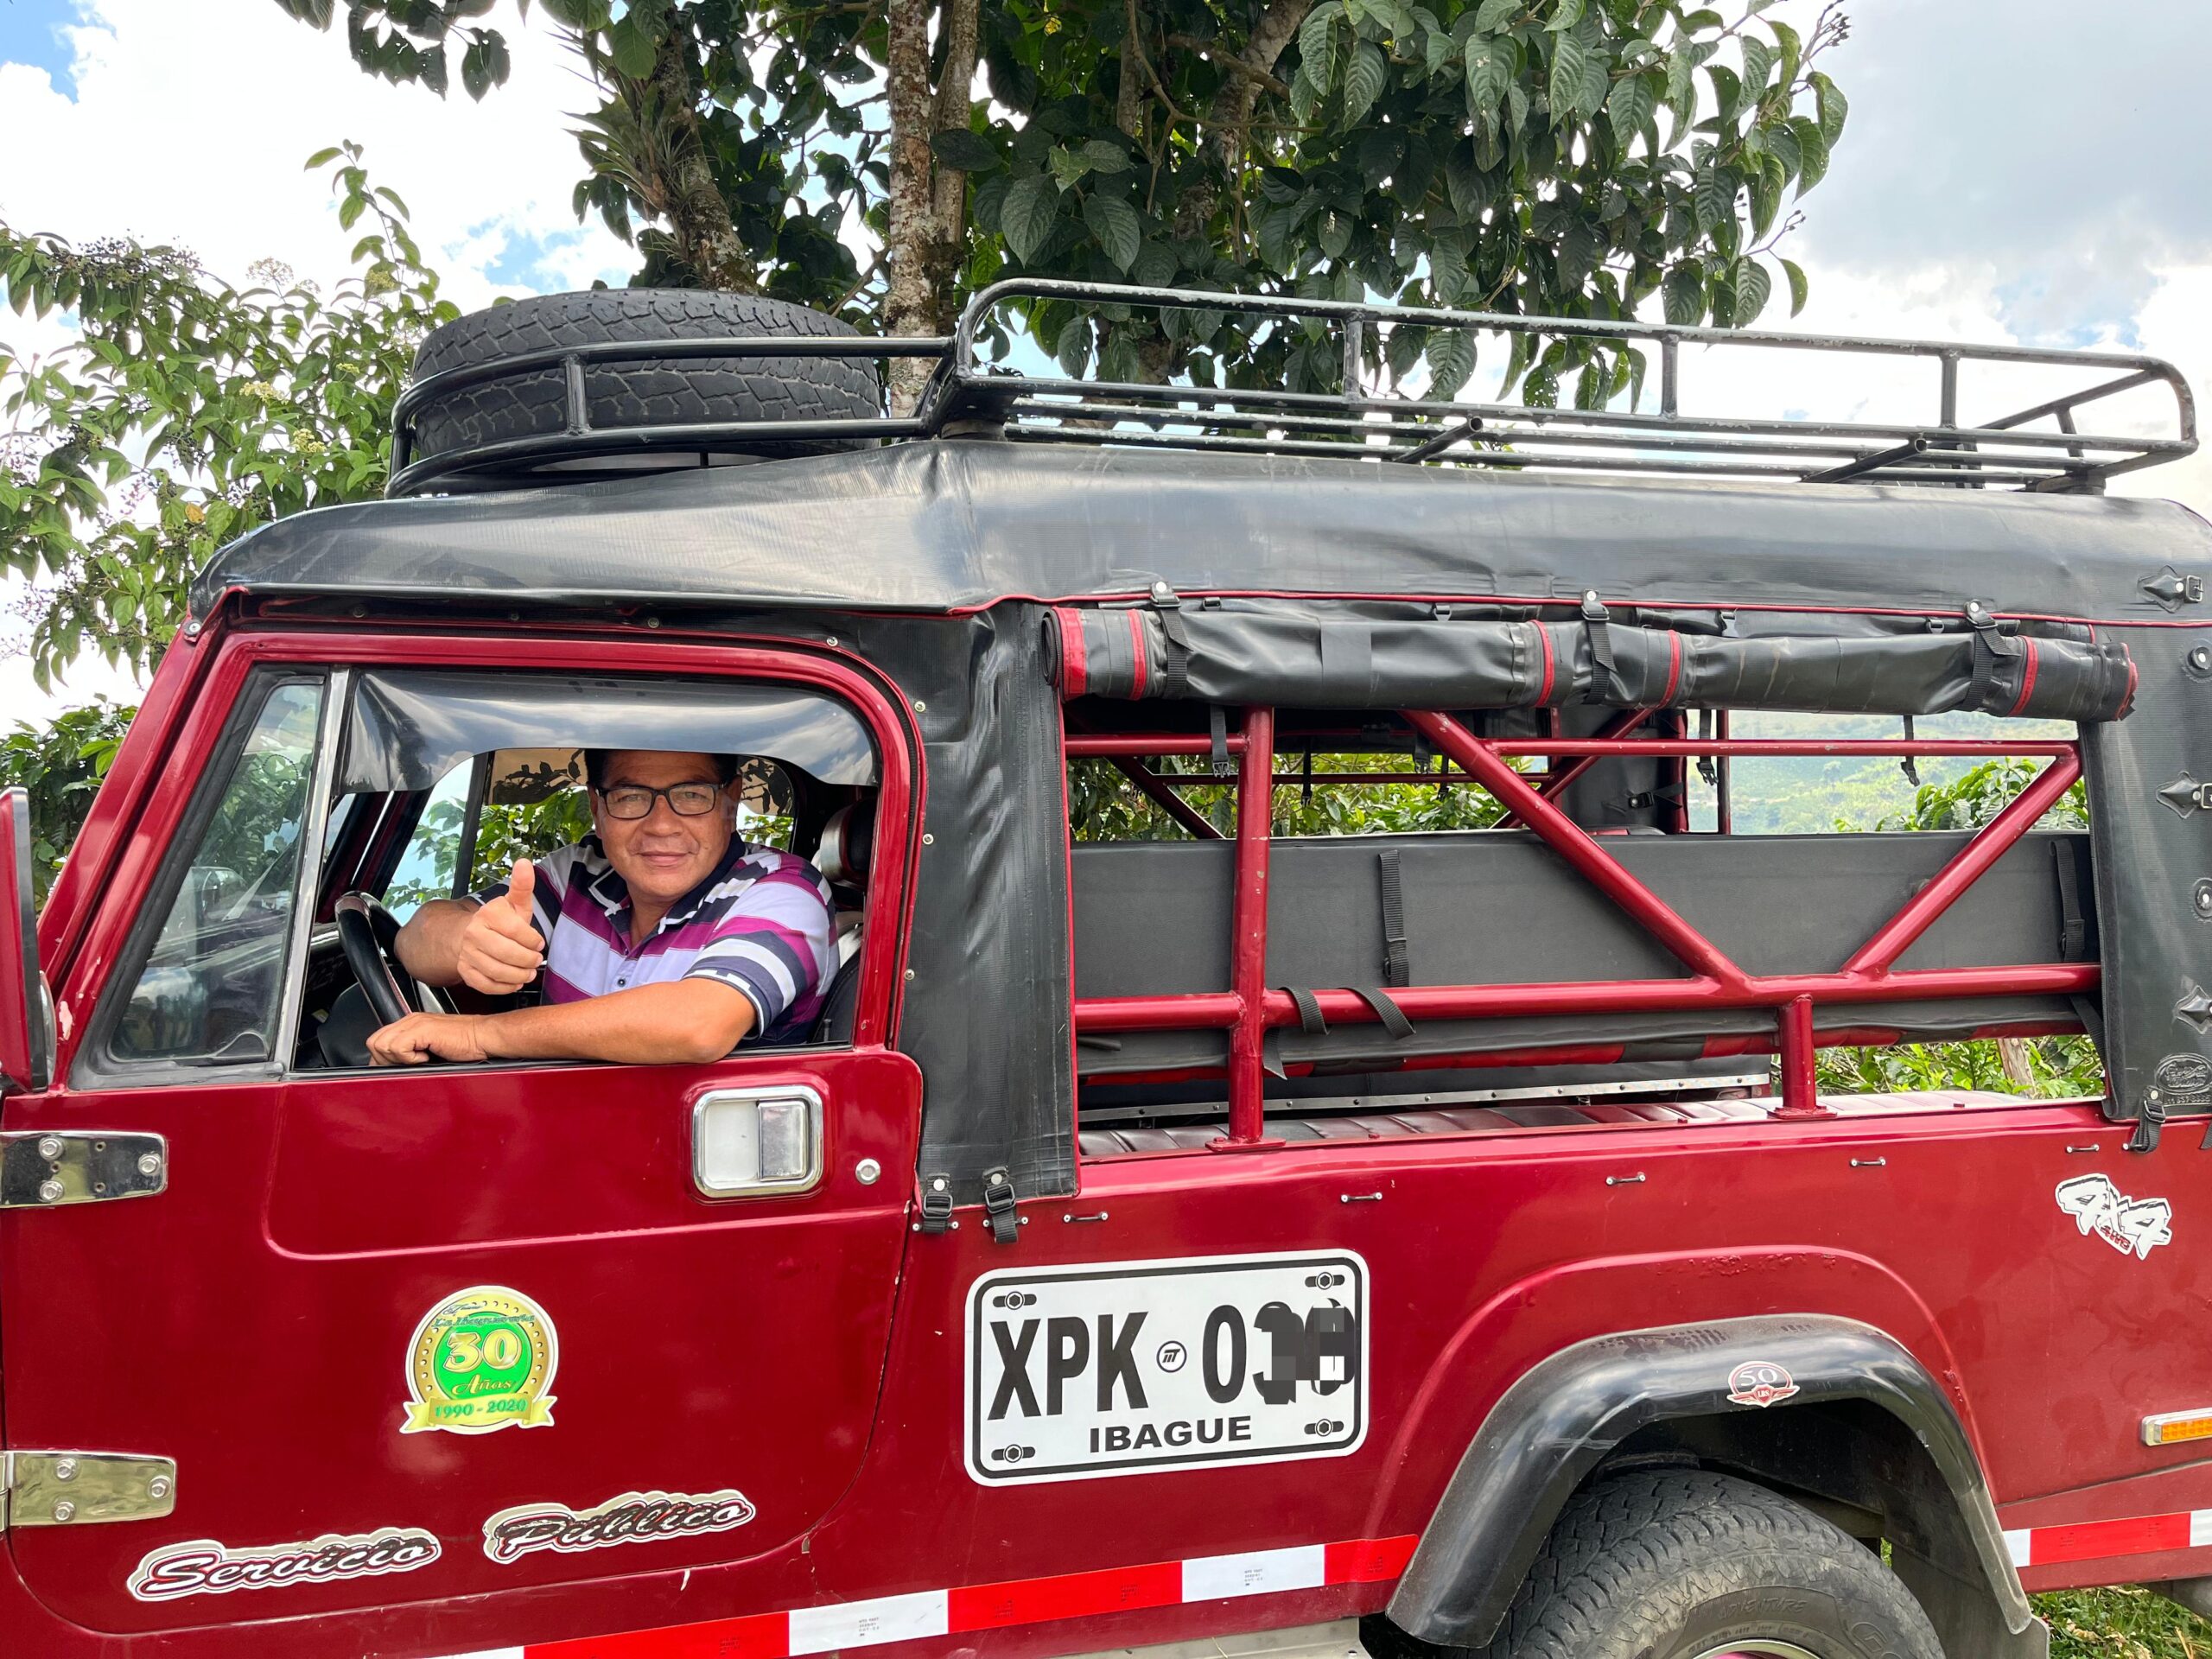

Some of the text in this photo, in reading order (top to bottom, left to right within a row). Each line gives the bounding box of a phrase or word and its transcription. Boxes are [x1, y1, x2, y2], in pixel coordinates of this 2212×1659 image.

[443, 1328, 523, 1373] 30
[987, 1311, 1150, 1421] XPK
[451, 1373, 513, 1395] Años
[1739, 1368, 1778, 1387] 50
[435, 1402, 474, 1419] 1990
[486, 1397, 528, 1414] 2020
[1090, 1414, 1252, 1453] IBAGUE
[138, 1540, 436, 1596] Servicio
